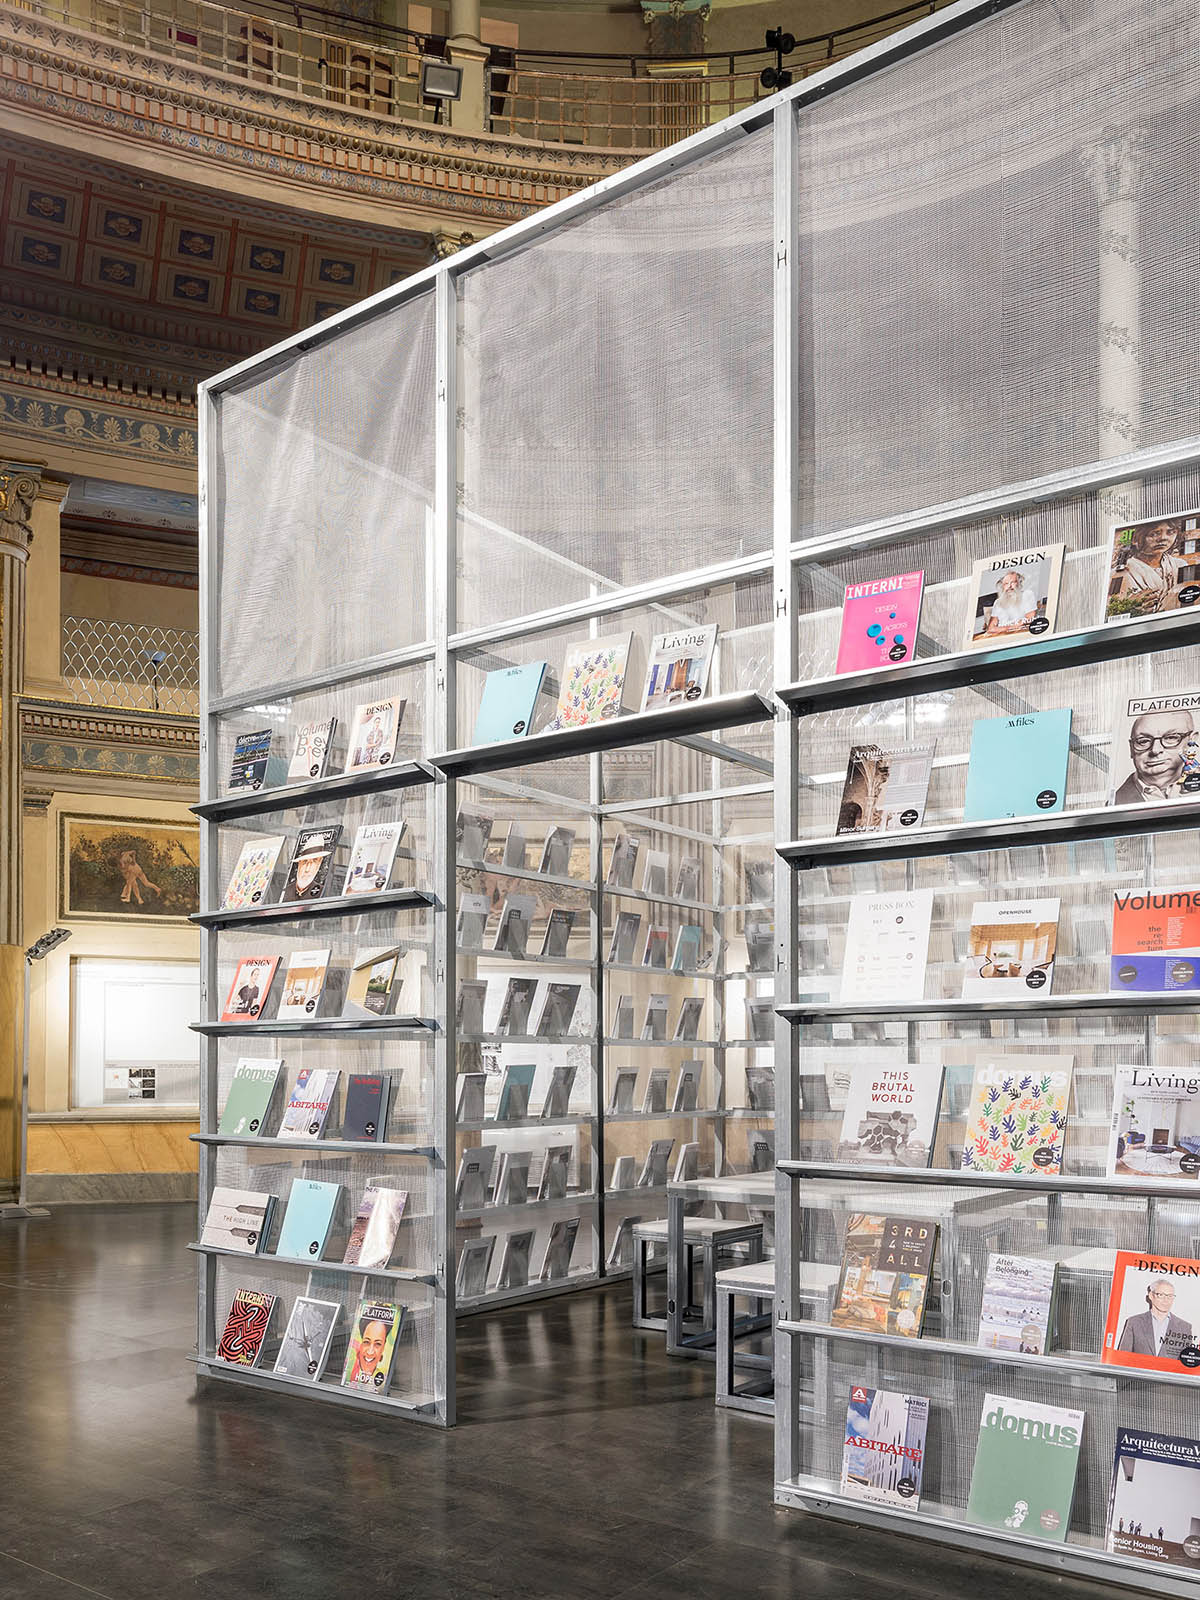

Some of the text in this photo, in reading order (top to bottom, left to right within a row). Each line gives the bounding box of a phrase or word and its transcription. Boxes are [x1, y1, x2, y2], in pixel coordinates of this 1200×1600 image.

[1120, 529, 1135, 542] ar
[991, 552, 1047, 571] DESIGN
[846, 577, 904, 599] INTERNI
[662, 634, 706, 650] Living
[366, 701, 393, 715] DESIGN
[1132, 696, 1200, 712] PLATFORM
[363, 827, 394, 840] Living
[1114, 890, 1200, 911] Volume
[868, 903, 895, 912] PRESS
[1137, 938, 1164, 946] search
[246, 959, 272, 967] DESIGN
[237, 1065, 277, 1081] domus
[883, 1071, 909, 1080] THIS
[871, 1082, 915, 1092] BRUTAL
[1132, 1070, 1200, 1094] Living
[871, 1094, 913, 1103] WORLD
[288, 1101, 329, 1110] ABITARE
[223, 1214, 233, 1222] THE
[996, 1258, 1014, 1266] After
[1138, 1260, 1200, 1277] DESIGN
[364, 1307, 394, 1319] PLATFORM
[1165, 1330, 1198, 1341] Jasper
[986, 1407, 1078, 1445] domus
[844, 1436, 922, 1459] ABITARE
[1133, 1540, 1163, 1553] Housing
